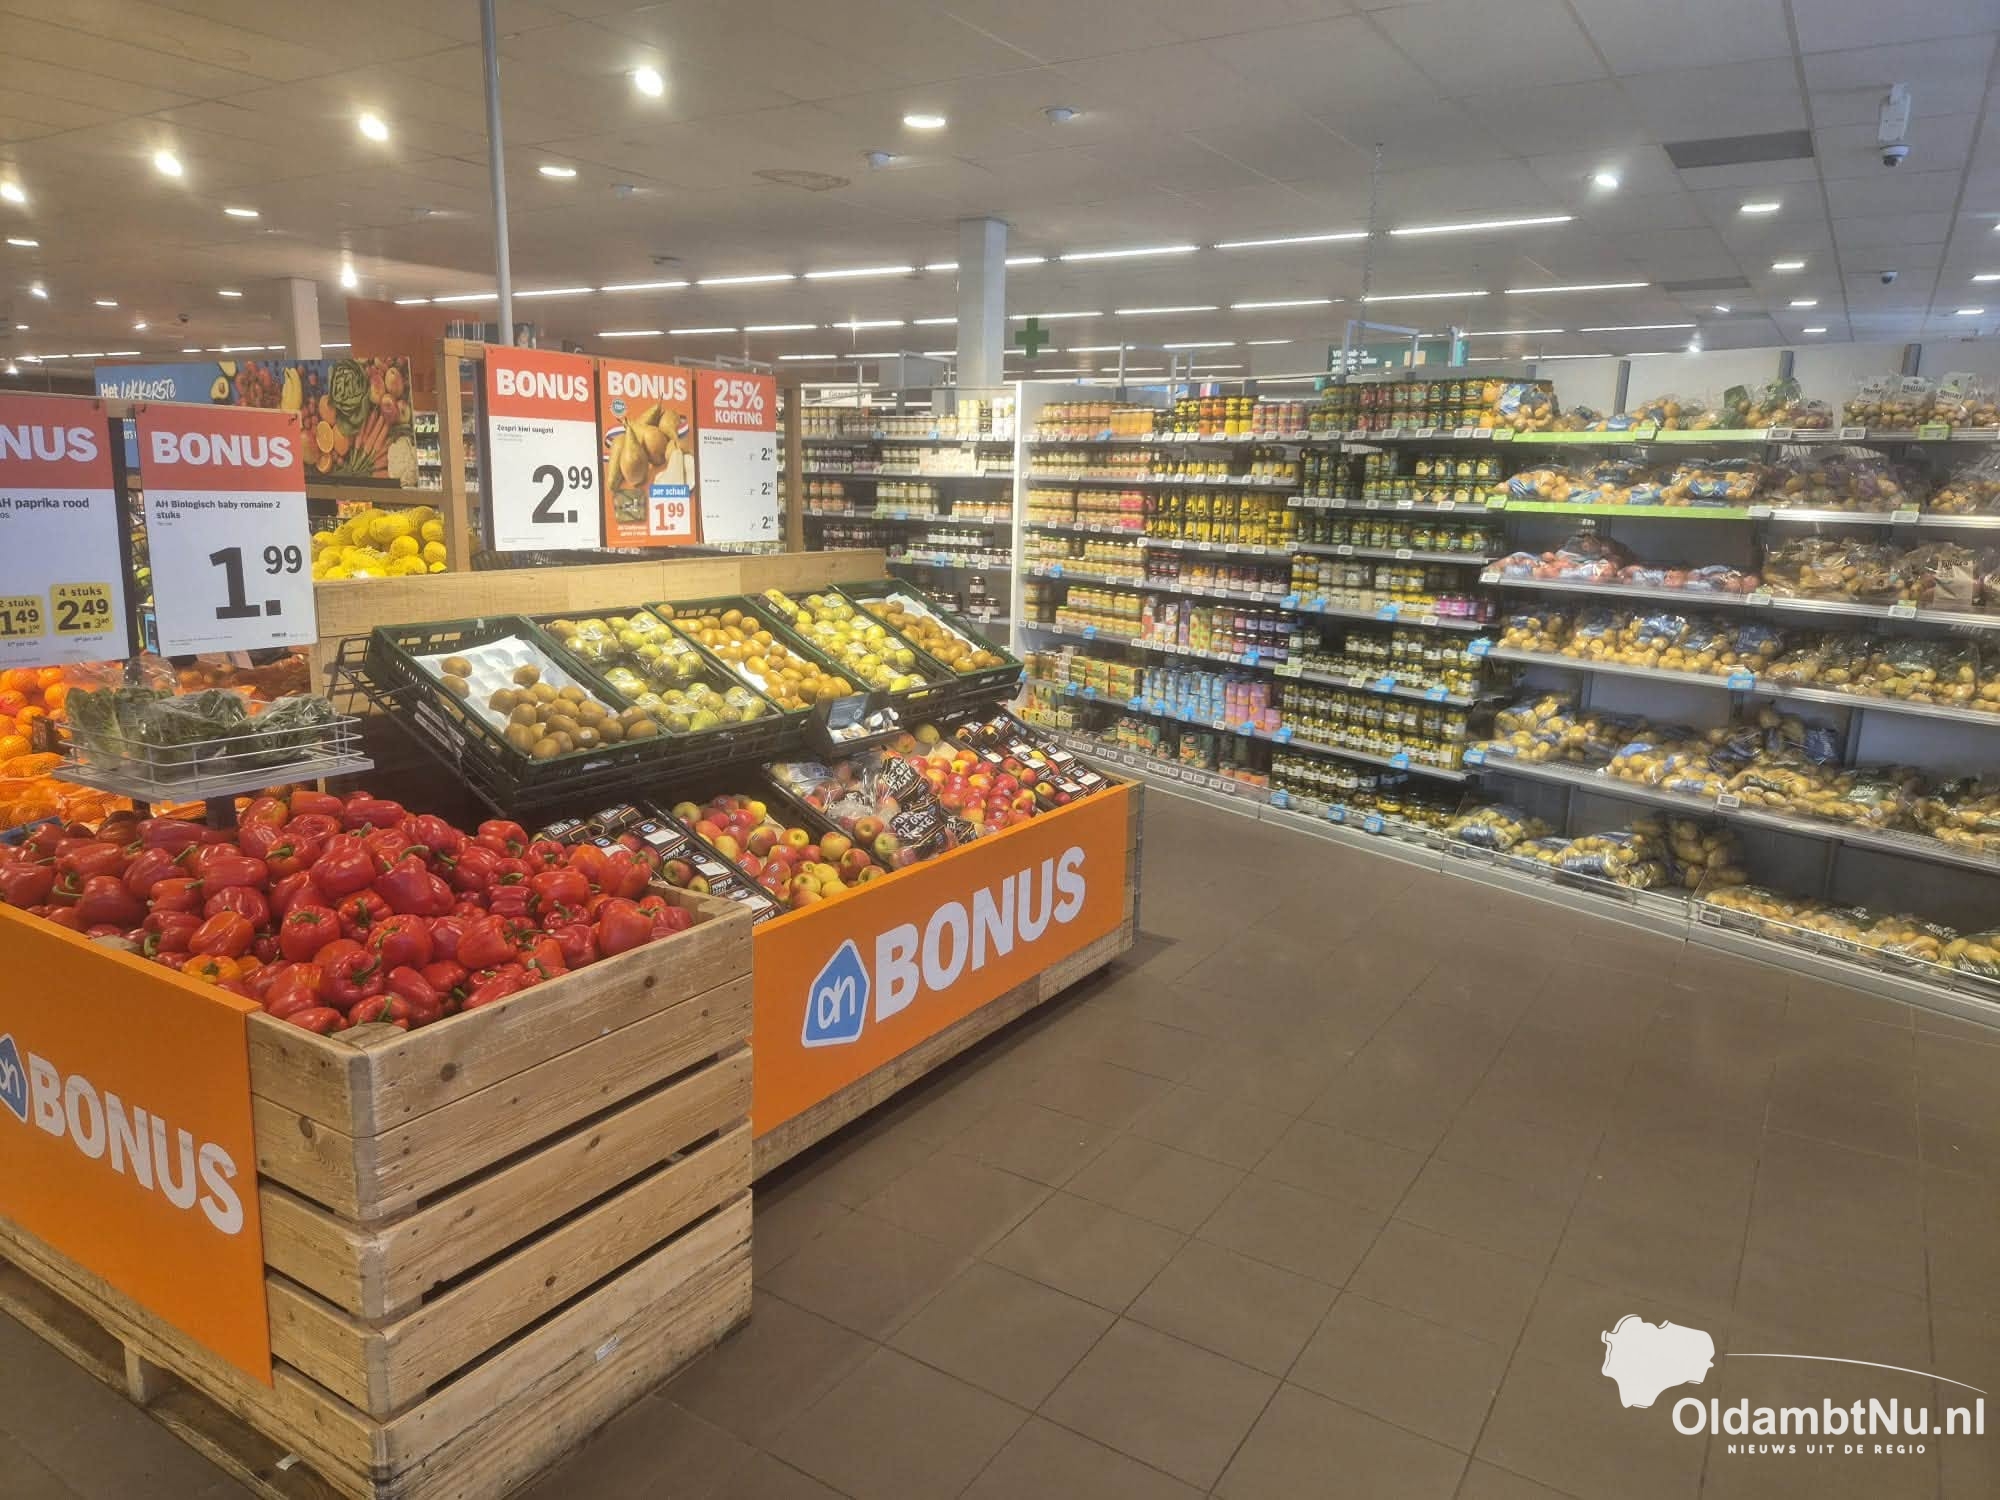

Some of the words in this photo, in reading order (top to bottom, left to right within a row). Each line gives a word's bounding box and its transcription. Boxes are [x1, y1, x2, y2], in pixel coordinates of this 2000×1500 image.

[101, 383, 118, 398] Het
[496, 368, 589, 402] BONUS
[608, 371, 687, 401] BONUS
[714, 378, 764, 410] 25%
[715, 409, 762, 425] KORTING
[151, 431, 293, 468] BONUS
[652, 488, 664, 497] per
[665, 486, 686, 496] schaal
[15, 497, 59, 510] paprika
[63, 498, 89, 508] rood
[155, 500, 169, 508] AH
[171, 500, 215, 510] Biologisch
[218, 500, 238, 510] baby
[240, 501, 273, 509] romaine
[156, 511, 181, 519] stuks
[59, 588, 66, 597] 4
[71, 586, 102, 597] stuks
[8, 598, 35, 607] stuks
[876, 846, 1086, 1024] BONUS
[28, 1052, 244, 1235] BONUS
